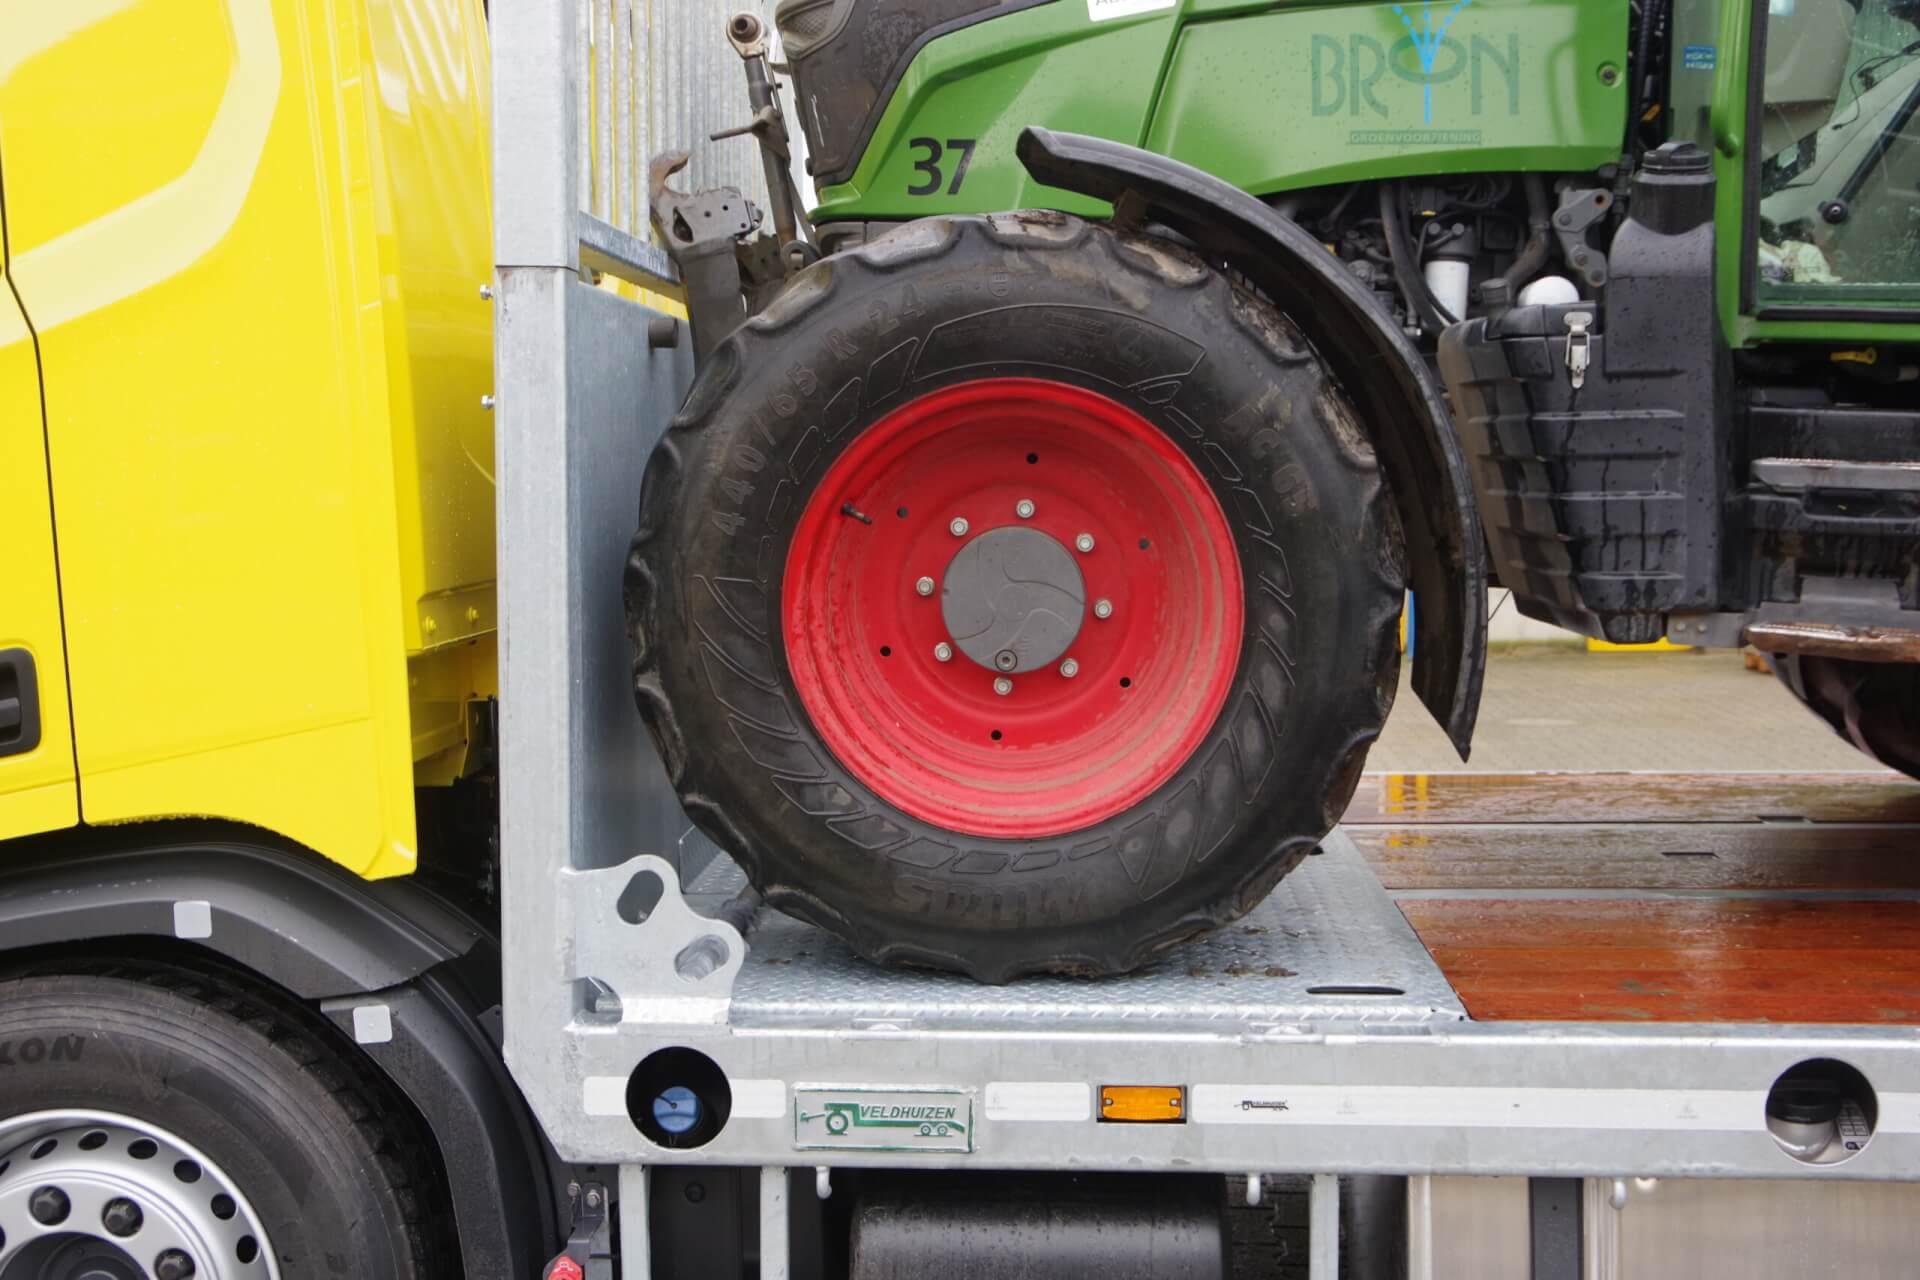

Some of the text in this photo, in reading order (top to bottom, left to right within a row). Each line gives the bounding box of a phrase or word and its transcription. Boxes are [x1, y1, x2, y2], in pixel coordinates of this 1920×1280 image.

[1311, 33, 1520, 119] BRON
[907, 137, 976, 196] 37
[860, 1106, 956, 1119] VELDHUIZEN
